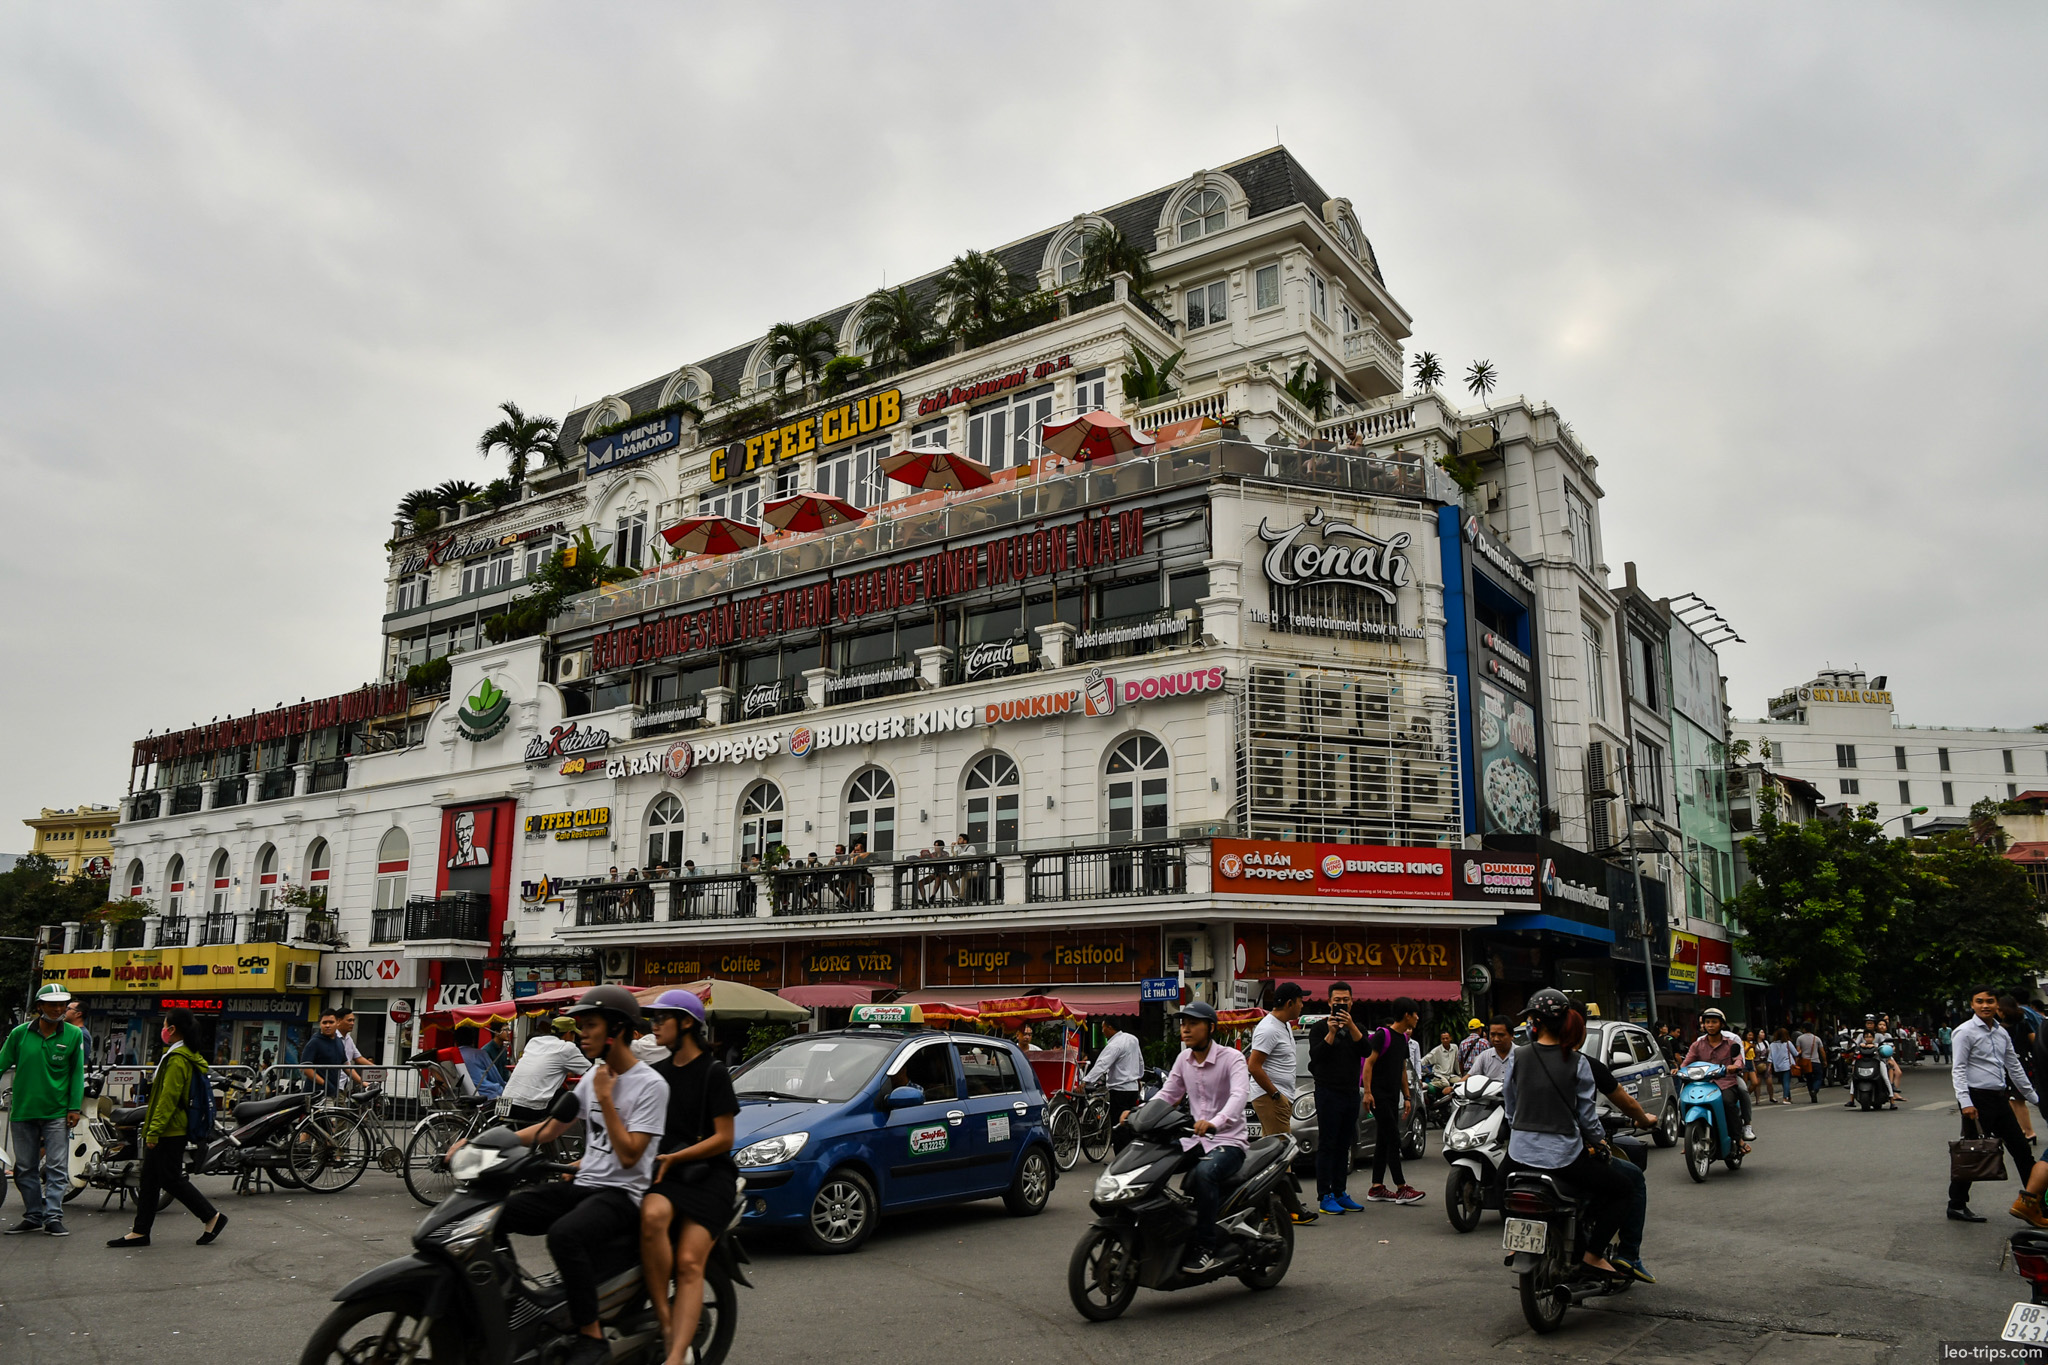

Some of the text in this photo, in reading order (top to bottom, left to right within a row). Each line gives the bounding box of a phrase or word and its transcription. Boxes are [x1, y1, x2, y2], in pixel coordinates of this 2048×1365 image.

[950, 367, 1028, 405] Restaurant
[1033, 363, 1055, 379] 4th
[821, 388, 902, 445] CLUB
[622, 419, 666, 445] MINH
[615, 431, 674, 461] DIAMOND
[424, 535, 495, 569] Kitchen
[696, 597, 735, 650] SẢN
[740, 587, 781, 642] VIỆT
[783, 582, 830, 632] NAM
[837, 561, 917, 624] QUANG
[922, 545, 978, 599] VINH
[986, 521, 1067, 587] MUÔN
[1076, 504, 1144, 568] NĂM
[1084, 632, 1098, 648] best
[1098, 623, 1142, 646] entertainment
[1143, 622, 1159, 639] show
[1160, 620, 1166, 636] in
[1167, 617, 1187, 635] Hanoi
[1295, 614, 1360, 632] entertainment
[1362, 621, 1387, 636] show
[1388, 623, 1397, 636] in
[1400, 624, 1426, 639] Hanoi
[879, 668, 893, 685] show
[1124, 665, 1224, 702] DONUTS
[1812, 688, 1892, 704] SKY BAR CAFE
[985, 690, 1078, 725] DUNKIN'
[818, 703, 974, 748] BURGER KING
[525, 721, 610, 762] the Kitchen
[791, 729, 810, 744] BURGER
[792, 736, 811, 753] KING
[560, 757, 586, 776] BBQ
[606, 755, 628, 779] GÀ
[630, 752, 664, 776] RÁN
[575, 807, 610, 827] CLUB
[572, 827, 608, 840] Restaurant
[1243, 851, 1291, 866] GÀ RÁN
[1325, 858, 1341, 868] BURGER
[1326, 863, 1342, 872] KING
[1346, 860, 1444, 876] BURGER KING
[1483, 862, 1535, 875] DUNKIN'
[1484, 875, 1533, 886] DONUTS
[1483, 887, 1534, 896] COFFEE & MORE
[237, 956, 270, 967] GoPro
[809, 951, 892, 973] LONG VÂN
[958, 948, 1010, 972] Burger
[1055, 943, 1124, 965] Fastfood
[1308, 938, 1448, 967] LONG VÂN
[212, 964, 235, 975] Canon
[335, 959, 374, 981] HSBC
[721, 955, 761, 973] Coffee
[43, 969, 66, 980] SONY
[1685, 969, 1696, 980] OFFICE
[435, 983, 480, 1006] KFC
[1144, 987, 1152, 998] LÊ
[1153, 986, 1167, 997] THÁI
[227, 998, 269, 1012] SAMSUNG
[270, 998, 303, 1017] Galaxy
[1520, 1223, 1532, 1236] 29
[2020, 1307, 2048, 1326] 88-
